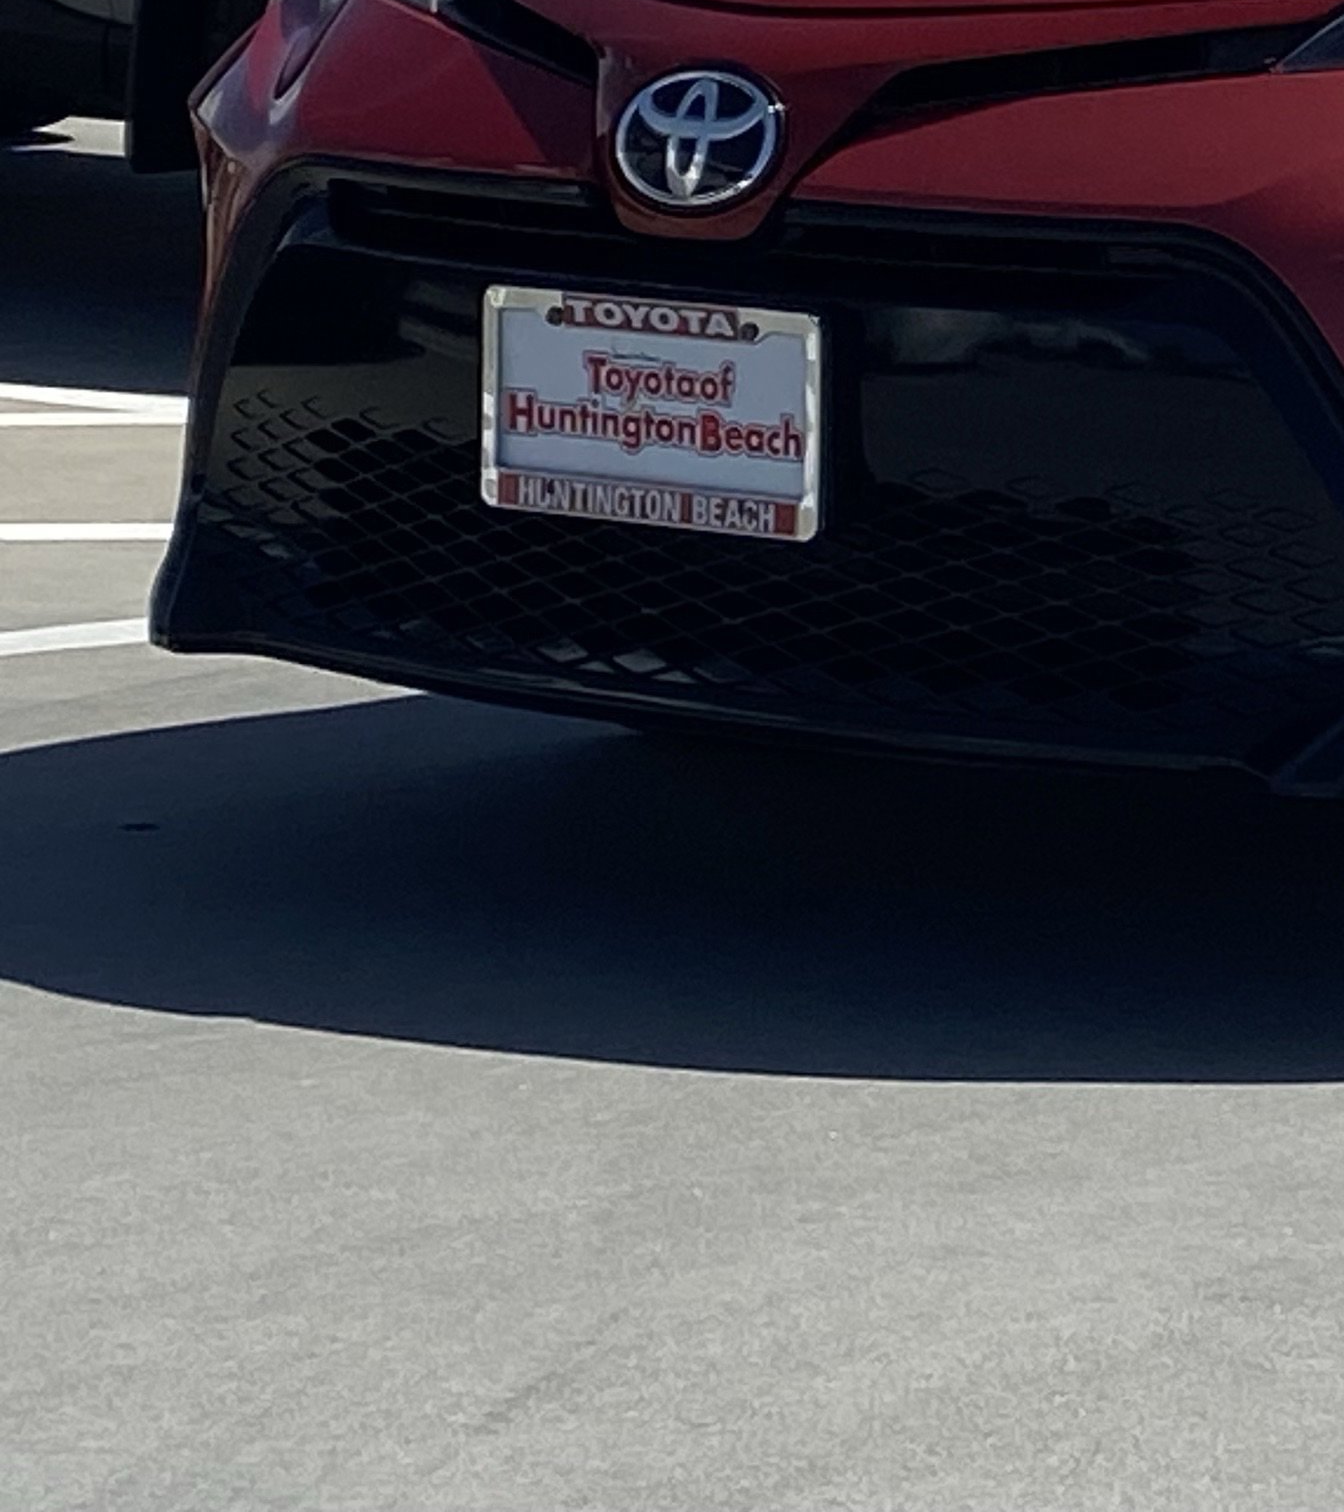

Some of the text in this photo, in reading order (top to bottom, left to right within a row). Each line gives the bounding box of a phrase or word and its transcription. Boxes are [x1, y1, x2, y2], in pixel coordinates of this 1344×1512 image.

[570, 300, 735, 337] TOYOTA
[518, 475, 776, 533] HUNTINGTON BEACH
